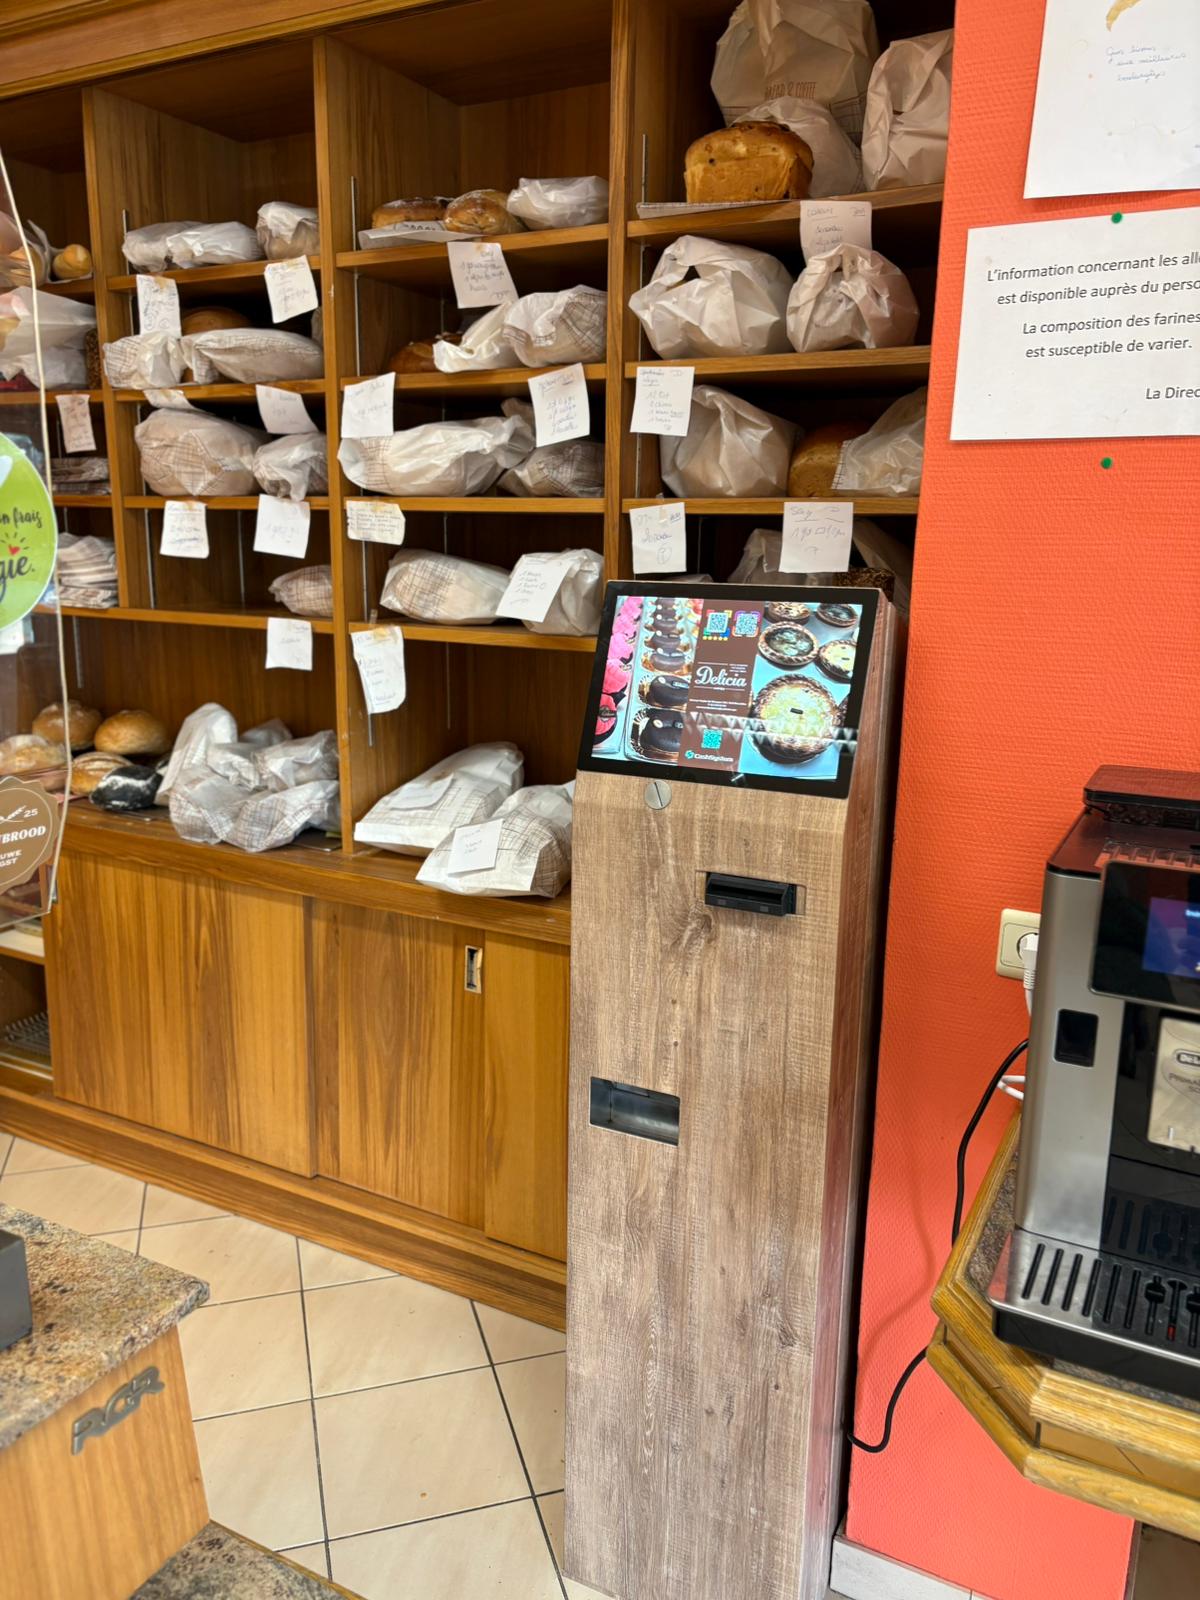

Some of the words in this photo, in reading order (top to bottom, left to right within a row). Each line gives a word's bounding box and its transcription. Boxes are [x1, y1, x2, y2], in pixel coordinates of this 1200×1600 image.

[987, 264, 1075, 282] L'information
[1078, 256, 1156, 273] concernant
[1158, 254, 1178, 267] les
[997, 293, 1017, 305] est
[1020, 286, 1087, 304] disponible
[1090, 283, 1138, 299] auprès
[1140, 281, 1159, 294] du
[1022, 323, 1037, 335] La
[1040, 317, 1123, 333] composition
[1126, 315, 1151, 327] des
[1154, 312, 1200, 326] farines
[1025, 346, 1045, 358] est
[1048, 341, 1124, 357] susceptible
[1126, 339, 1144, 352] de
[1147, 338, 1193, 351] varier.
[1145, 387, 1161, 400] La
[13, 507, 42, 529] frais
[694, 665, 748, 687] Delicia
[24, 808, 38, 818] 25
[0, 824, 46, 844] BROOD
